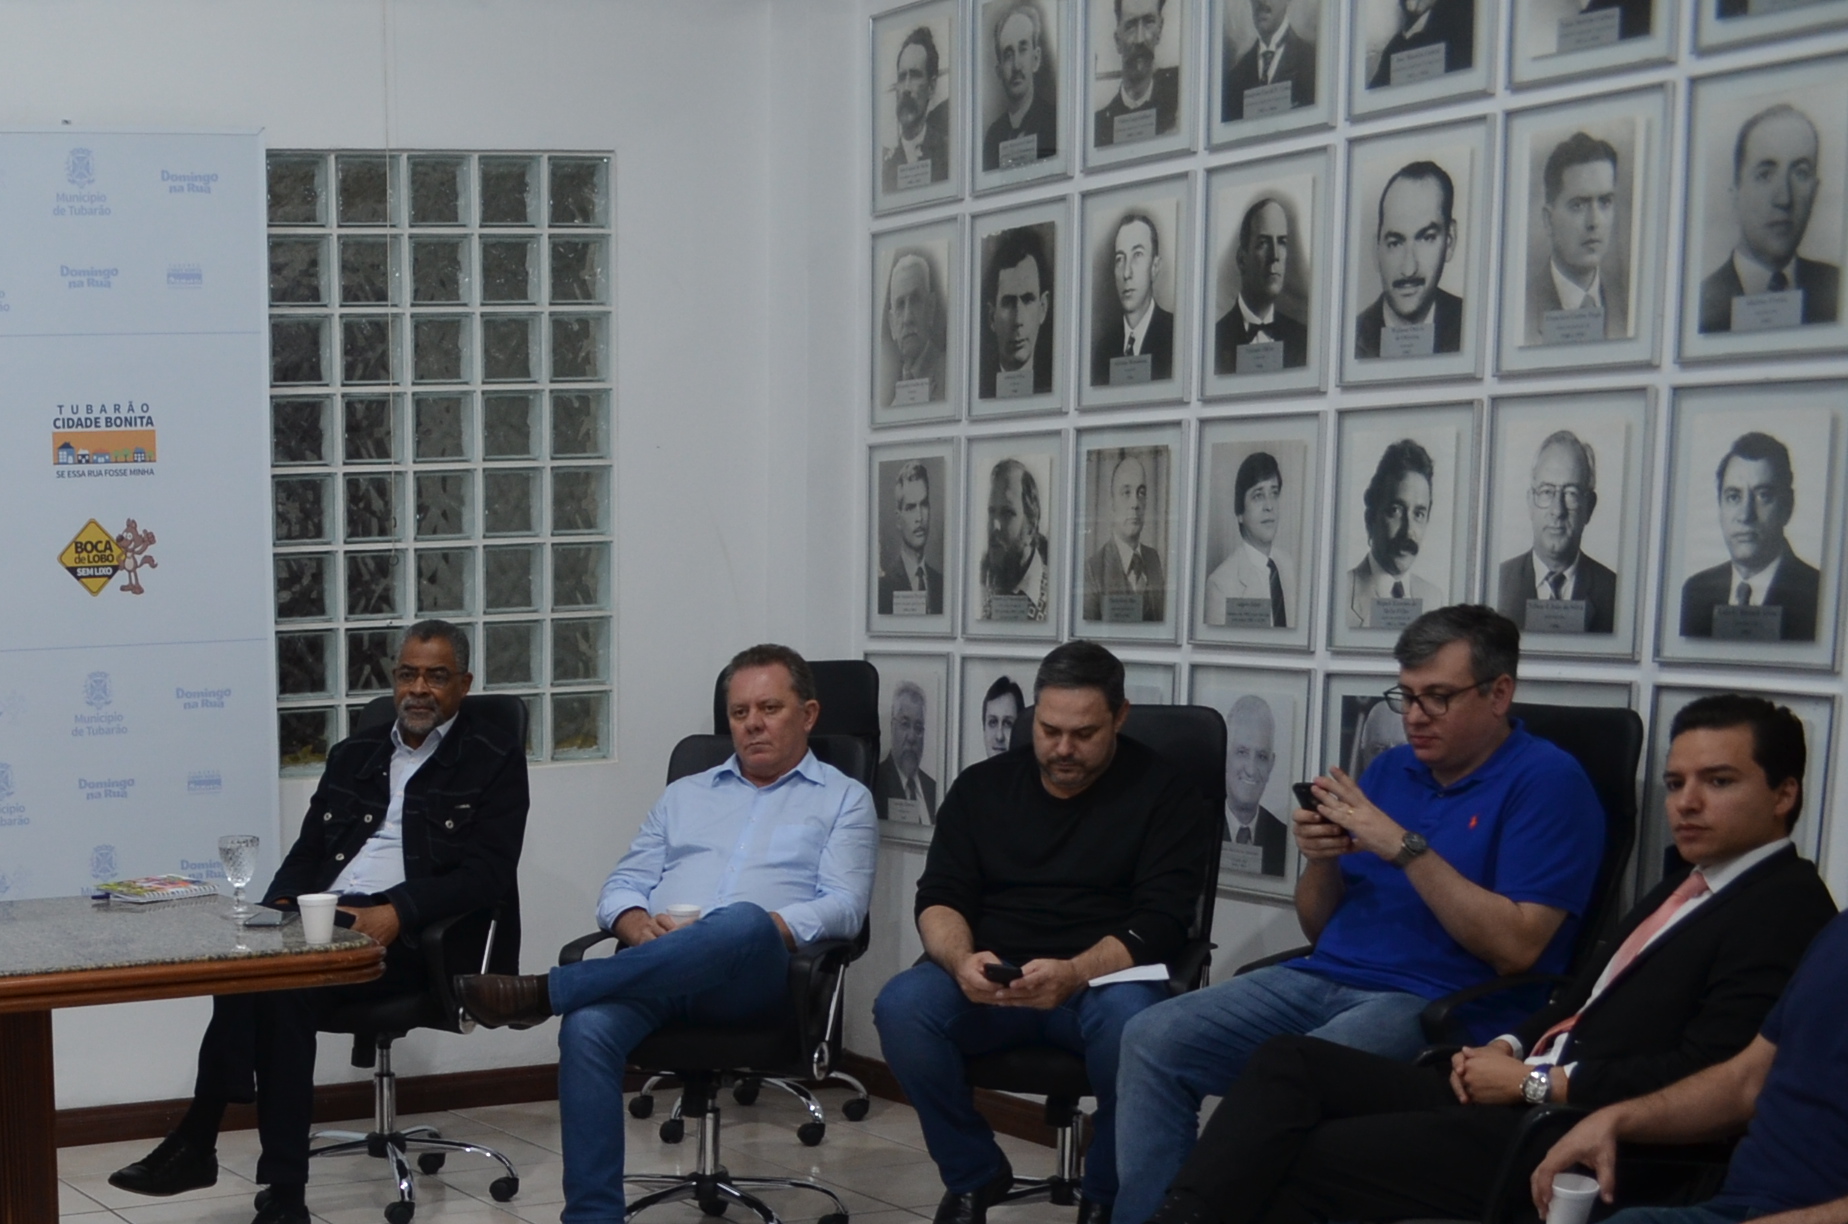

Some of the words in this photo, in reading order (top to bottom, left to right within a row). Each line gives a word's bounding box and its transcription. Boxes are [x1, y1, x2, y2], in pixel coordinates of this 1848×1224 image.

[161, 170, 218, 185] Domingo
[188, 181, 211, 194] Rua
[60, 266, 118, 280] Domingo
[86, 276, 112, 289] Rua
[57, 401, 149, 415] TUBARÃO
[53, 416, 101, 430] CIDADE
[104, 415, 154, 428] BONITA
[56, 470, 65, 478] SE
[67, 470, 85, 478] ESSA
[87, 469, 103, 478] RUA
[104, 468, 127, 477] FOSSE
[129, 467, 154, 476] MINHA
[74, 540, 113, 554] BOCA
[74, 554, 85, 564] de
[87, 553, 114, 564] LOBO
[76, 567, 96, 576] SEM
[96, 566, 112, 576] LIXO
[175, 686, 231, 700] Domingo
[201, 697, 225, 709] Rua
[78, 778, 134, 792] Domingo
[104, 788, 128, 799] Rua
